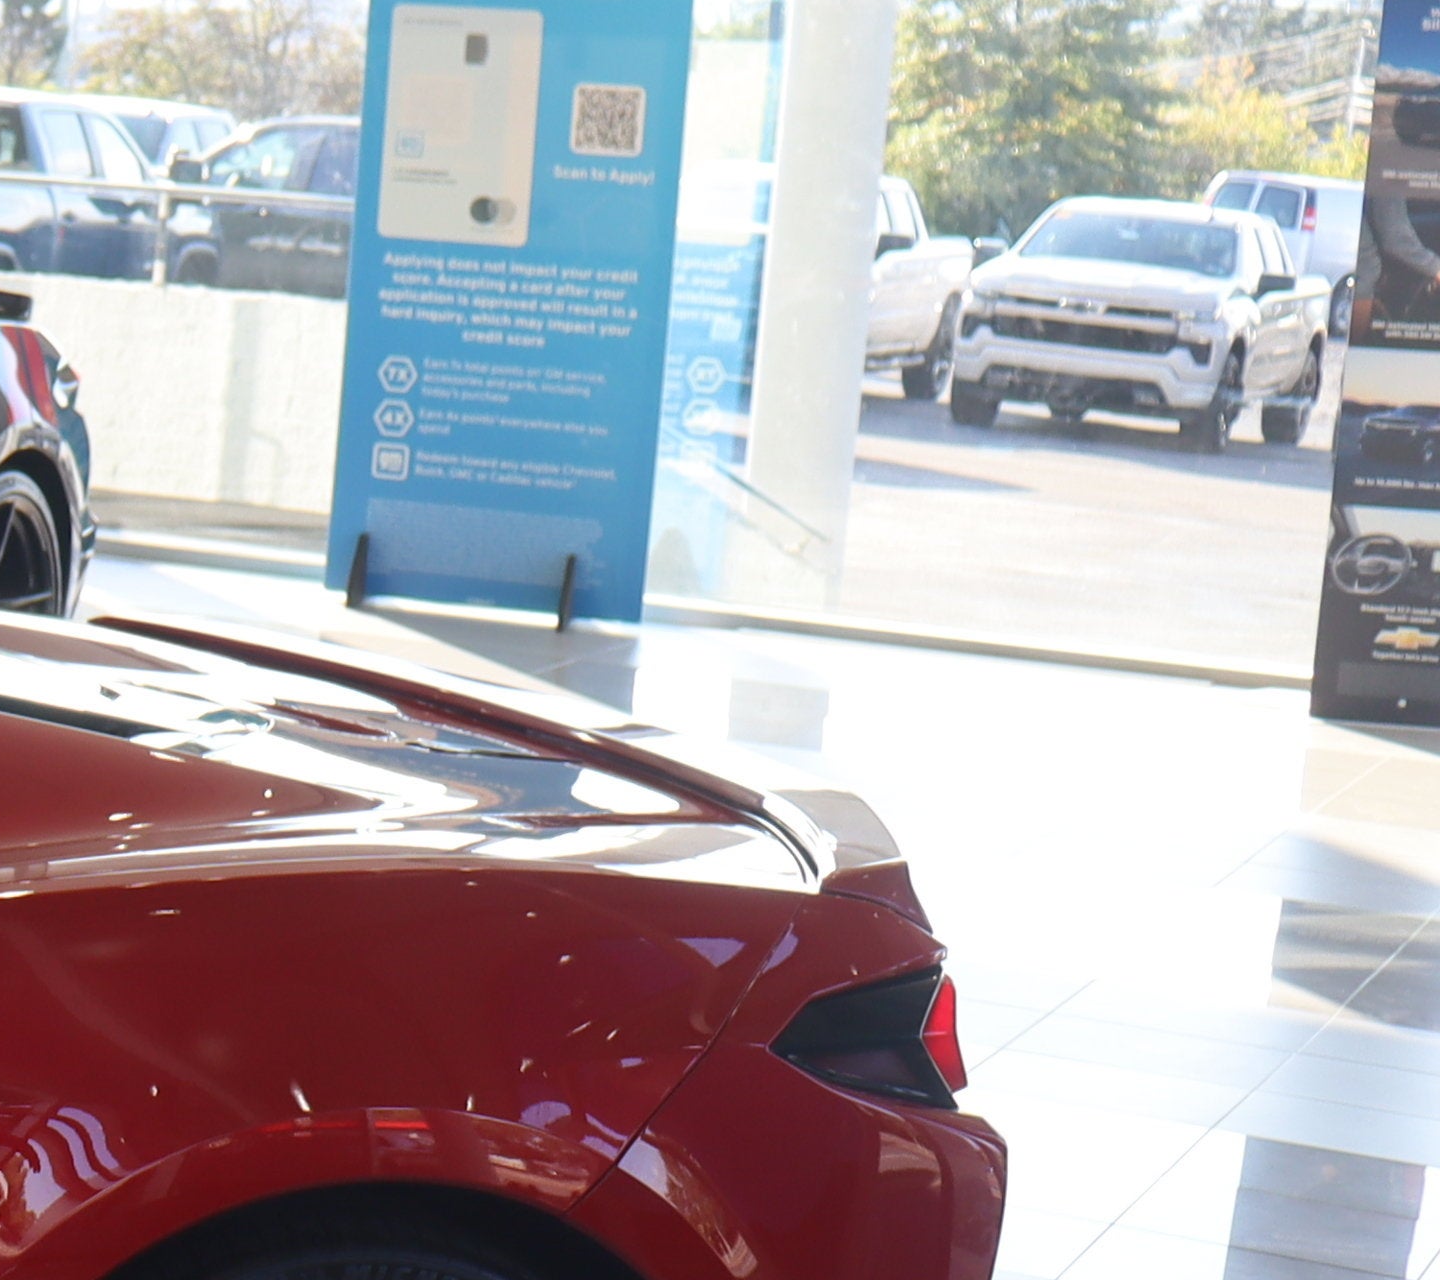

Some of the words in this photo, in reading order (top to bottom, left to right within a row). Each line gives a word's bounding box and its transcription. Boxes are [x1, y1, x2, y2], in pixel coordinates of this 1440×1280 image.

[553, 164, 588, 180] Scan
[591, 165, 607, 181] to
[610, 168, 655, 186] Apply!
[384, 252, 444, 270] Applying
[448, 258, 479, 271] does
[484, 259, 507, 272] not
[510, 261, 557, 278] impact
[562, 267, 593, 282] your
[597, 269, 638, 284] credit
[436, 273, 506, 293] Accepting
[510, 281, 519, 291] a
[521, 280, 553, 295] card
[556, 283, 589, 297] after
[594, 286, 626, 302] your
[379, 288, 454, 306] application
[458, 293, 468, 307] is
[472, 295, 538, 313] approved
[541, 299, 565, 314] will
[568, 302, 608, 317] result
[612, 304, 625, 319] in
[628, 308, 638, 320] a
[382, 305, 414, 319] hard
[471, 312, 511, 327] which
[515, 316, 544, 331] may
[549, 318, 596, 336] impact
[600, 322, 631, 338] your
[462, 329, 503, 344] credit
[507, 333, 546, 348] score
[386, 366, 409, 382] 7X
[382, 410, 407, 425] 4X
